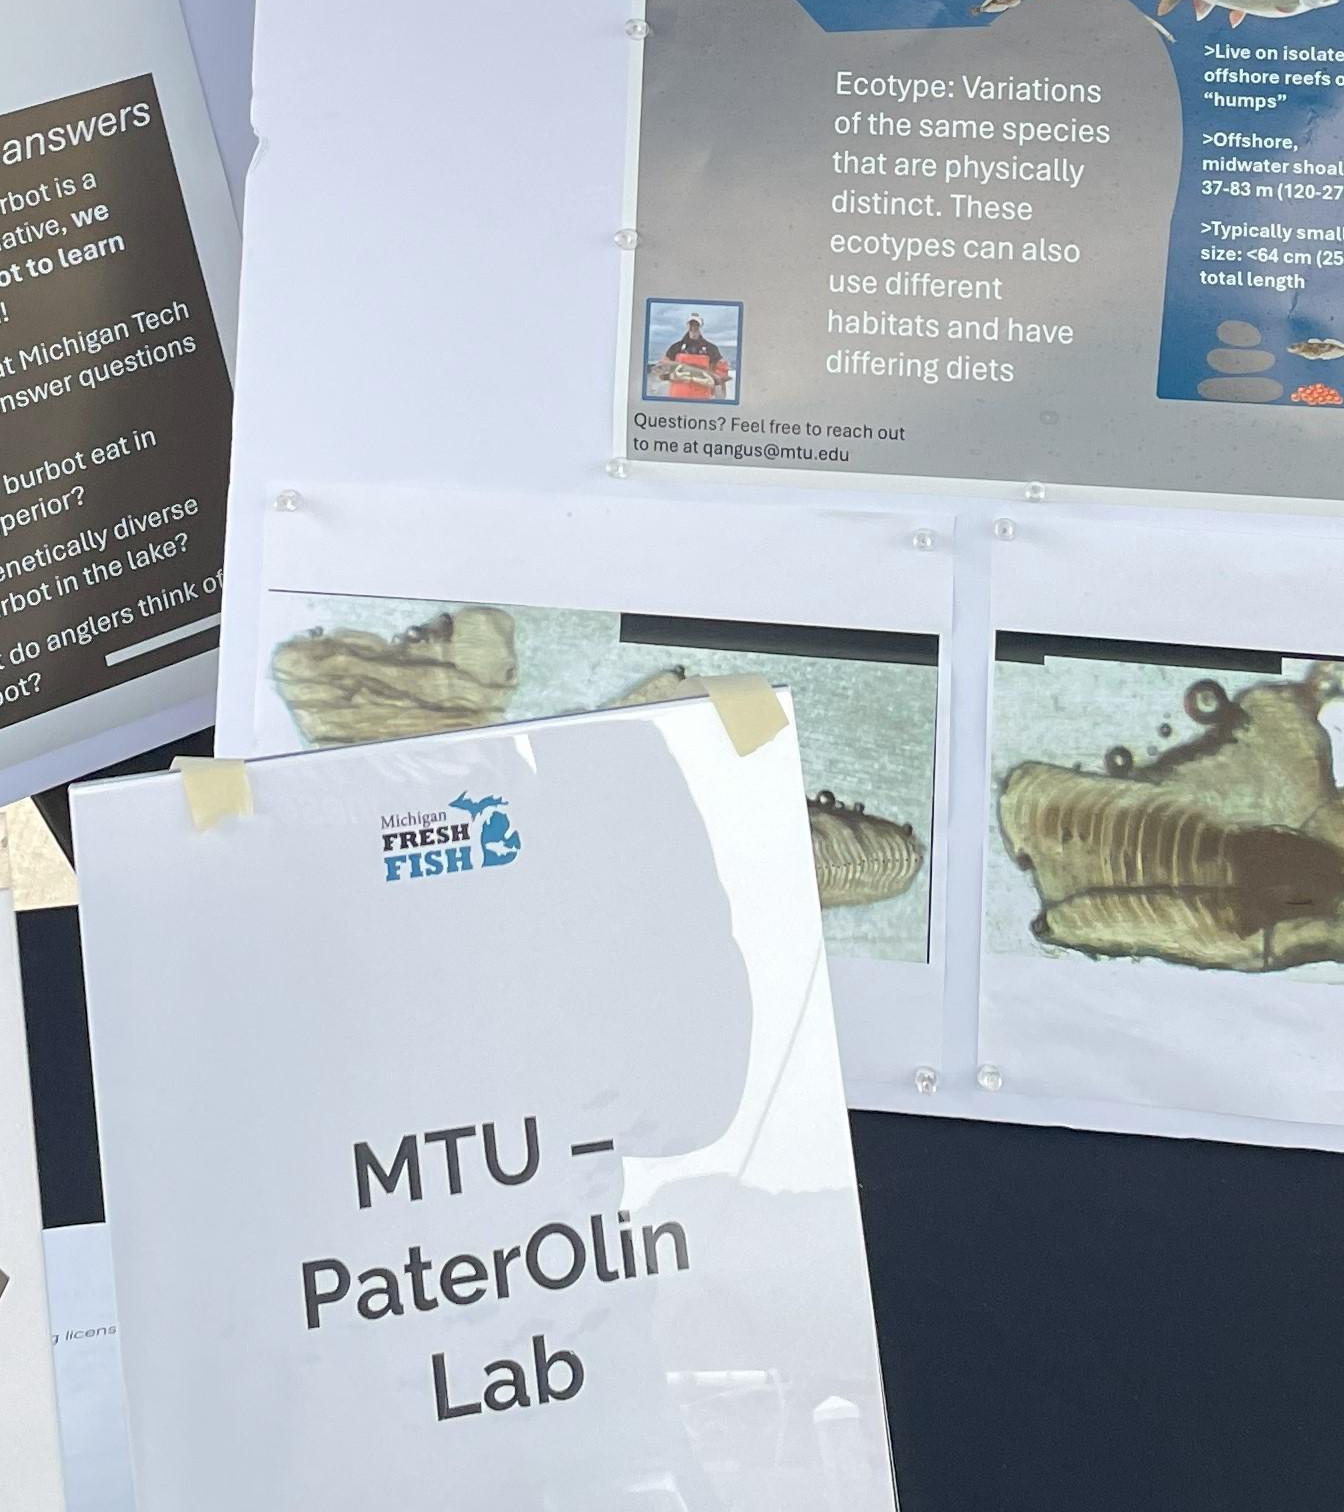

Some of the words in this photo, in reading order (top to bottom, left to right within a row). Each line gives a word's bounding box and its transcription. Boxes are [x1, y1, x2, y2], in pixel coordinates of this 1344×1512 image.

[1203, 43, 1252, 60] >Live
[1254, 48, 1279, 61] on
[1203, 67, 1281, 85] offshore
[1284, 70, 1332, 87] reefs
[2, 102, 151, 166] answers
[633, 411, 727, 432] Questions?
[730, 416, 766, 434] Feel
[768, 418, 802, 436] free
[805, 421, 823, 437] to
[826, 423, 874, 440] reach
[877, 426, 906, 442] out
[633, 436, 650, 452] to
[653, 440, 679, 454] me
[682, 439, 699, 455] at
[702, 442, 850, 464] qangus@mtu.edu
[380, 810, 447, 830] Michigan
[381, 823, 471, 852] FRESH
[383, 845, 474, 882] FISH
[353, 1115, 541, 1210] MTU
[301, 1210, 691, 1331] PaterOlin
[431, 1333, 585, 1422] Lab
